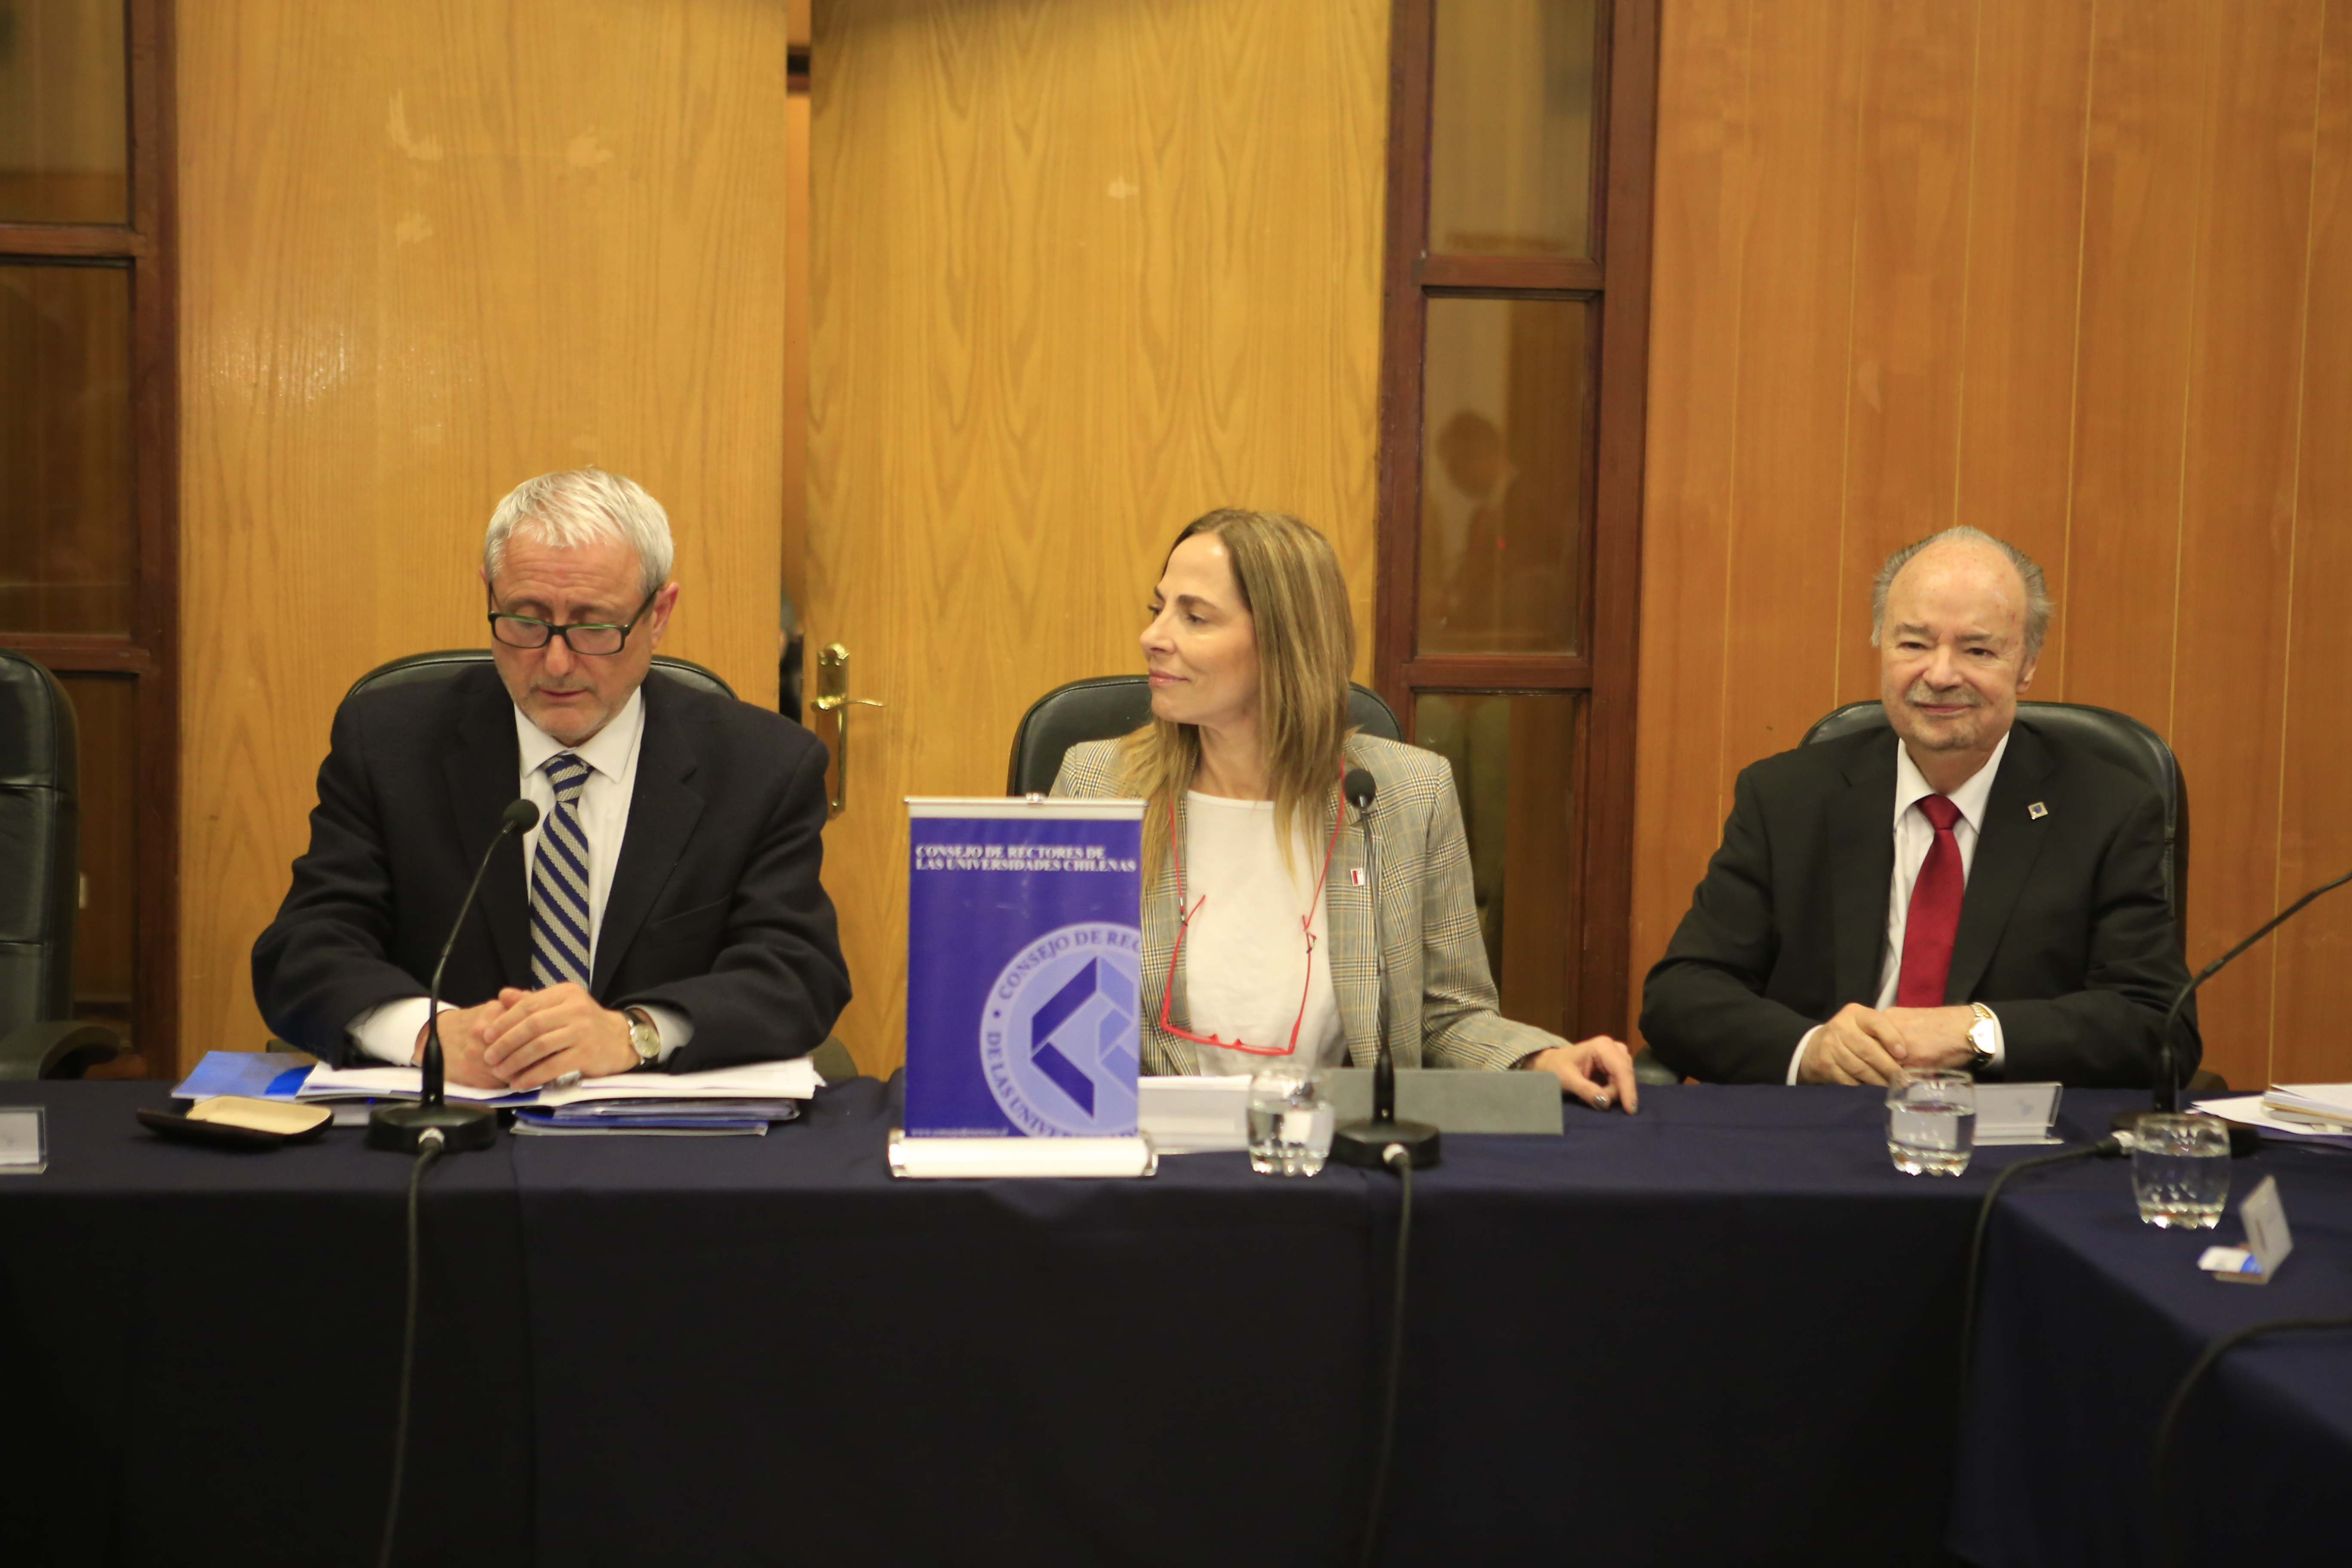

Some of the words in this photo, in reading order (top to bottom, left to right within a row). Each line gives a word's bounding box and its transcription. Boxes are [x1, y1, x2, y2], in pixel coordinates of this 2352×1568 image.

[916, 845, 983, 858] CONSEJO
[985, 845, 1004, 859] DE
[1007, 845, 1084, 859] RECTORES
[1086, 846, 1106, 859] DE
[916, 858, 945, 870] LAS
[946, 859, 1062, 871] UNIVERSIDADES
[1063, 859, 1137, 872] CHILENAS
[998, 936, 1069, 1000] CONSEJO
[1075, 930, 1102, 946] DE
[986, 1032, 1002, 1060] DE
[990, 1062, 1015, 1099] LAS
